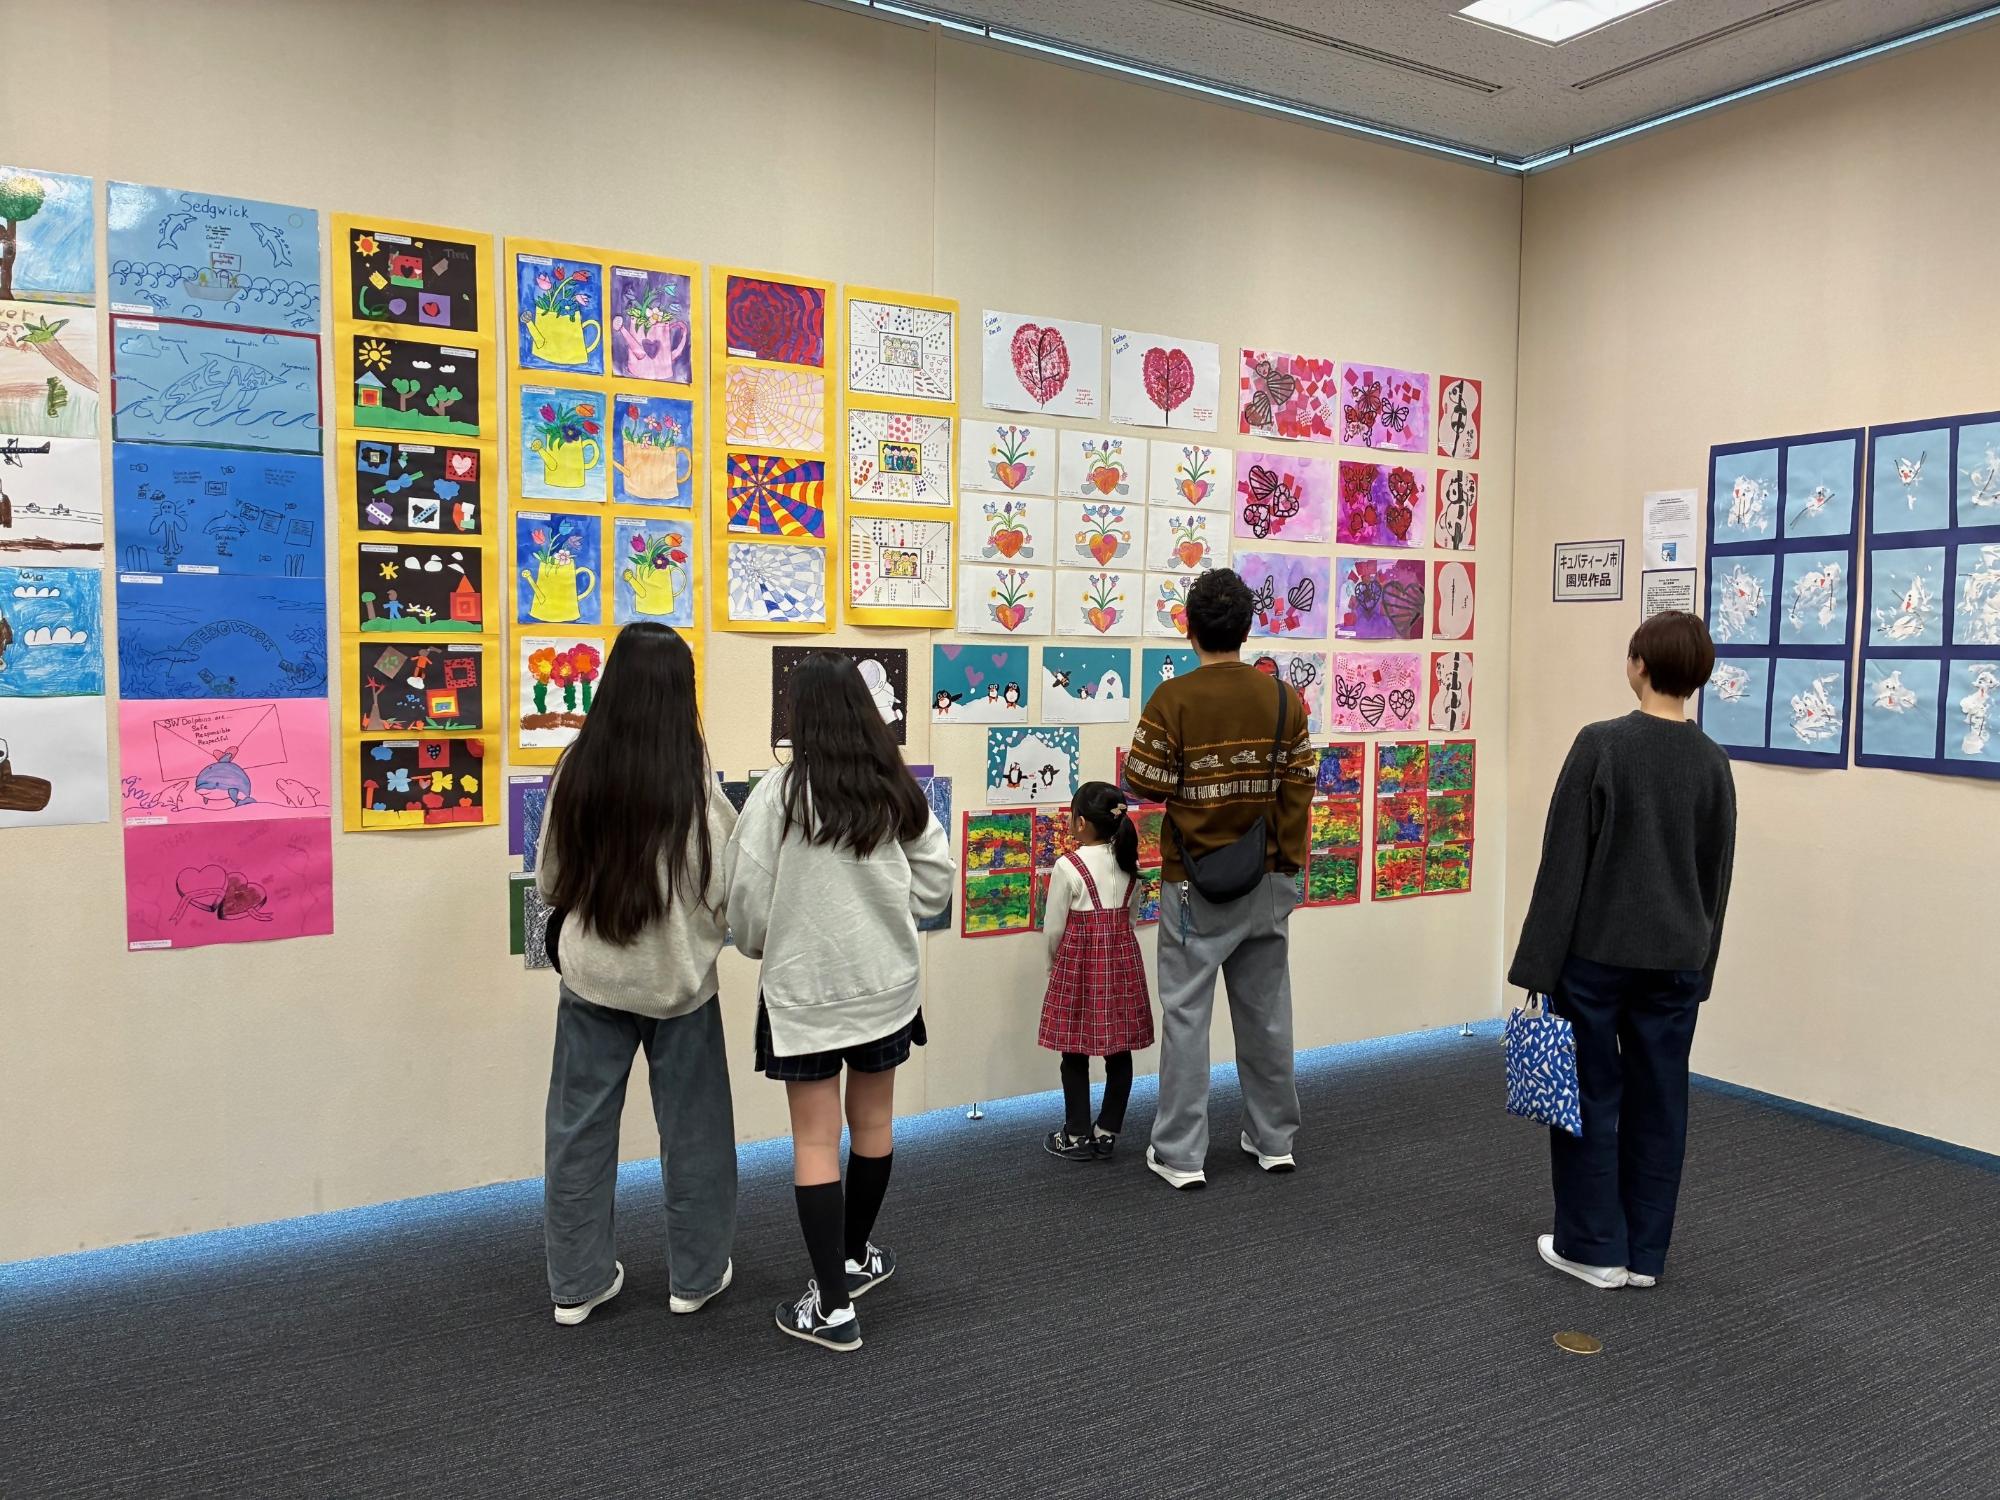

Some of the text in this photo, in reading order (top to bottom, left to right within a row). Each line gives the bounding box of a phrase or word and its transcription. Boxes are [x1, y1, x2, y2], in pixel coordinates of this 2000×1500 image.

[180, 193, 248, 219] Sedgwick
[1560, 552, 1618, 570] キュパティーノ市
[1566, 572, 1611, 588] 園児作品
[191, 723, 208, 732] Safe
[195, 728, 231, 739] Responsible
[198, 735, 229, 745] Respectful
[1198, 784, 1220, 799] FUTURE
[1239, 780, 1250, 793] THE
[871, 1256, 883, 1273] N
